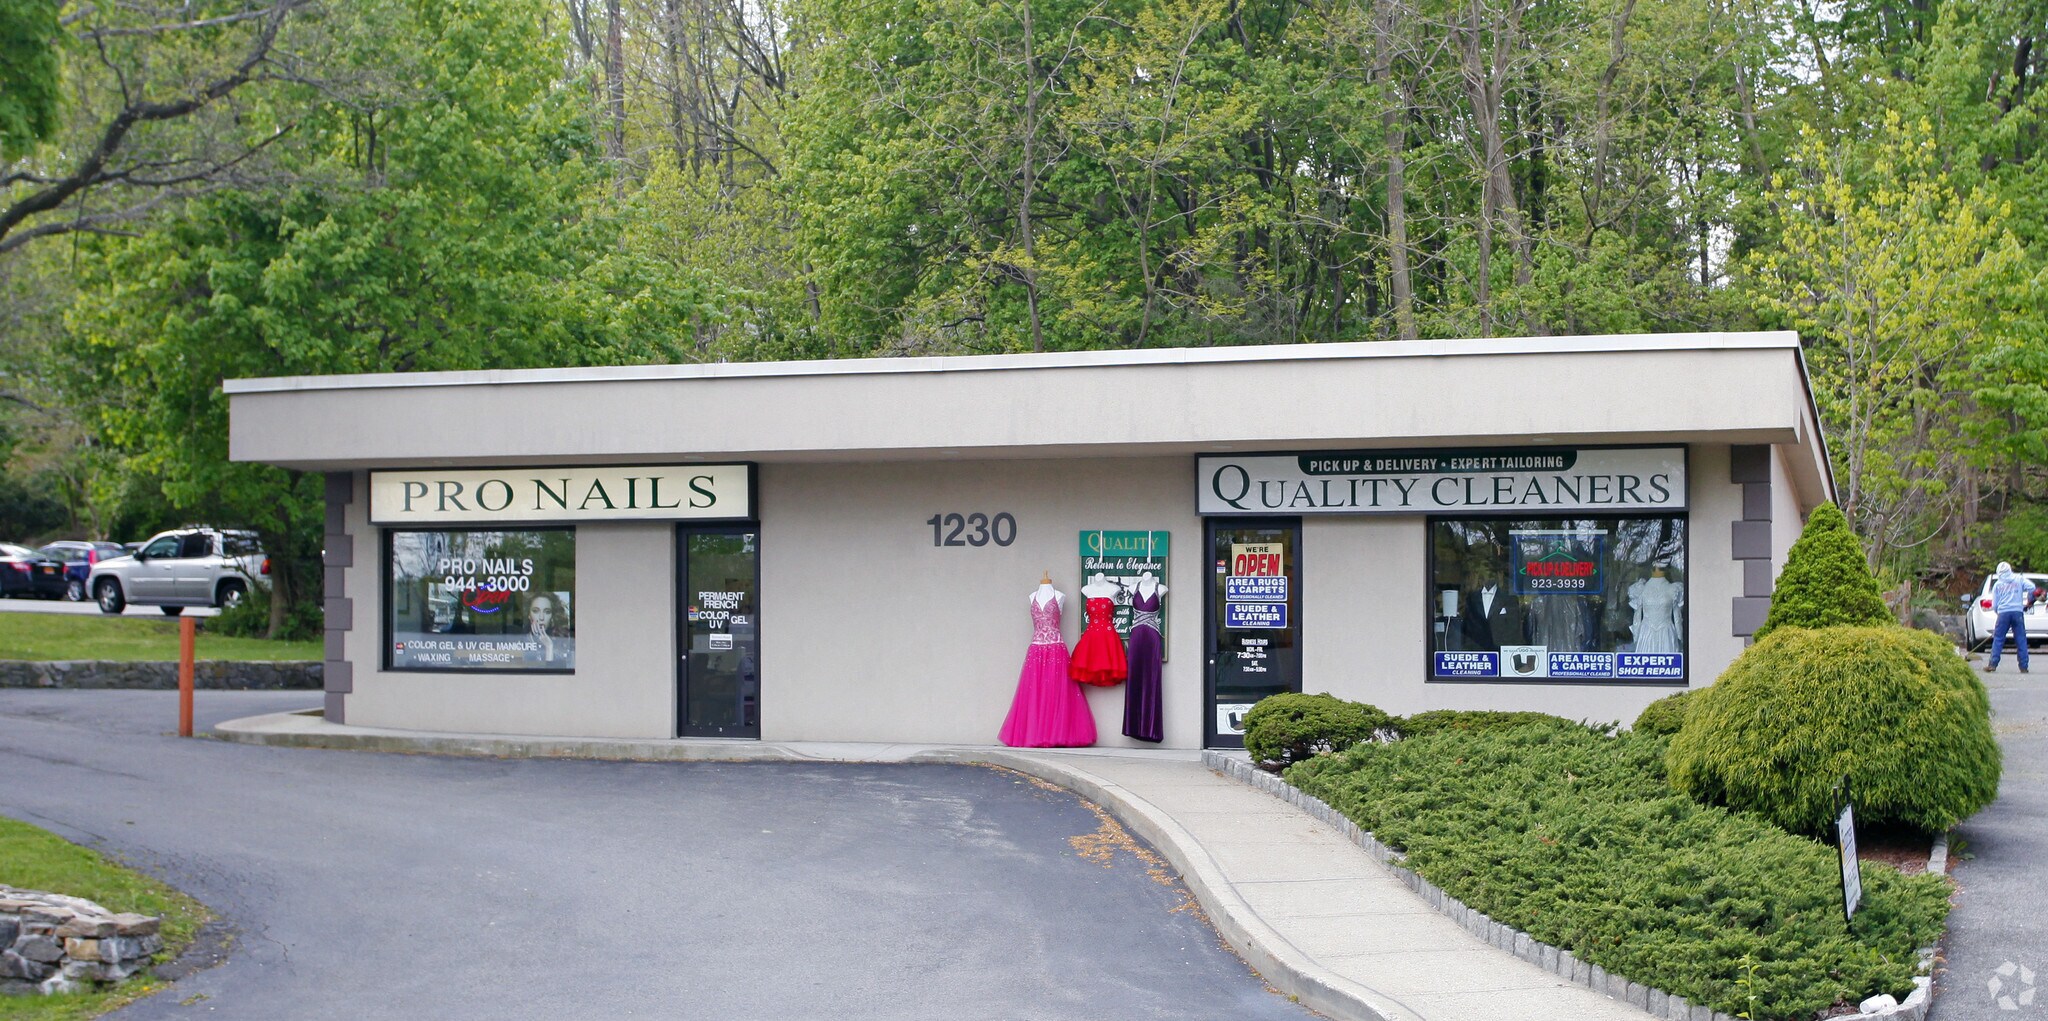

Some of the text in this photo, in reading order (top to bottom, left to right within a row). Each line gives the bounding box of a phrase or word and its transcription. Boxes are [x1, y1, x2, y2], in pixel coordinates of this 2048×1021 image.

[1310, 455, 1563, 472] PICK UP & DELIVERY EXPERT TAILORING
[1212, 464, 1671, 511] QUALITY CLEANERS
[401, 475, 717, 512] PRO NAILS
[926, 511, 1017, 547] 1230
[1087, 532, 1159, 552] QUALITY
[440, 558, 534, 576] PRO NAILS
[1085, 556, 1162, 575] Return to Elegance
[1234, 553, 1280, 577] OPEN
[1526, 562, 1544, 577] PICK
[1544, 562, 1553, 577] UP
[1561, 562, 1594, 577] DELIVERY
[444, 576, 530, 593] 944-3000
[1228, 578, 1285, 586] AREA RUGS
[1531, 578, 1586, 589] 923-3939
[1228, 586, 1285, 594] & CARPETS
[698, 591, 745, 601] PERMAENT
[703, 600, 738, 610] FRENCH
[1234, 604, 1278, 613] SUEDE &
[1116, 607, 1130, 616] with
[1232, 612, 1281, 621] LEATHER
[699, 610, 749, 625] COLOR GEL
[709, 620, 723, 629] UV
[408, 640, 538, 651] COLOR GEL & UV GEL MANICURE
[417, 652, 511, 662] WAXING MASSAGE
[1443, 653, 1489, 662] SUEDE &
[1550, 654, 1612, 663] AREA RUGS
[1624, 655, 1675, 666] EXPERT
[1441, 661, 1492, 670] LEATHER
[1551, 663, 1612, 671] & CARPETS
[1618, 667, 1681, 676] SHOE REPAIR
